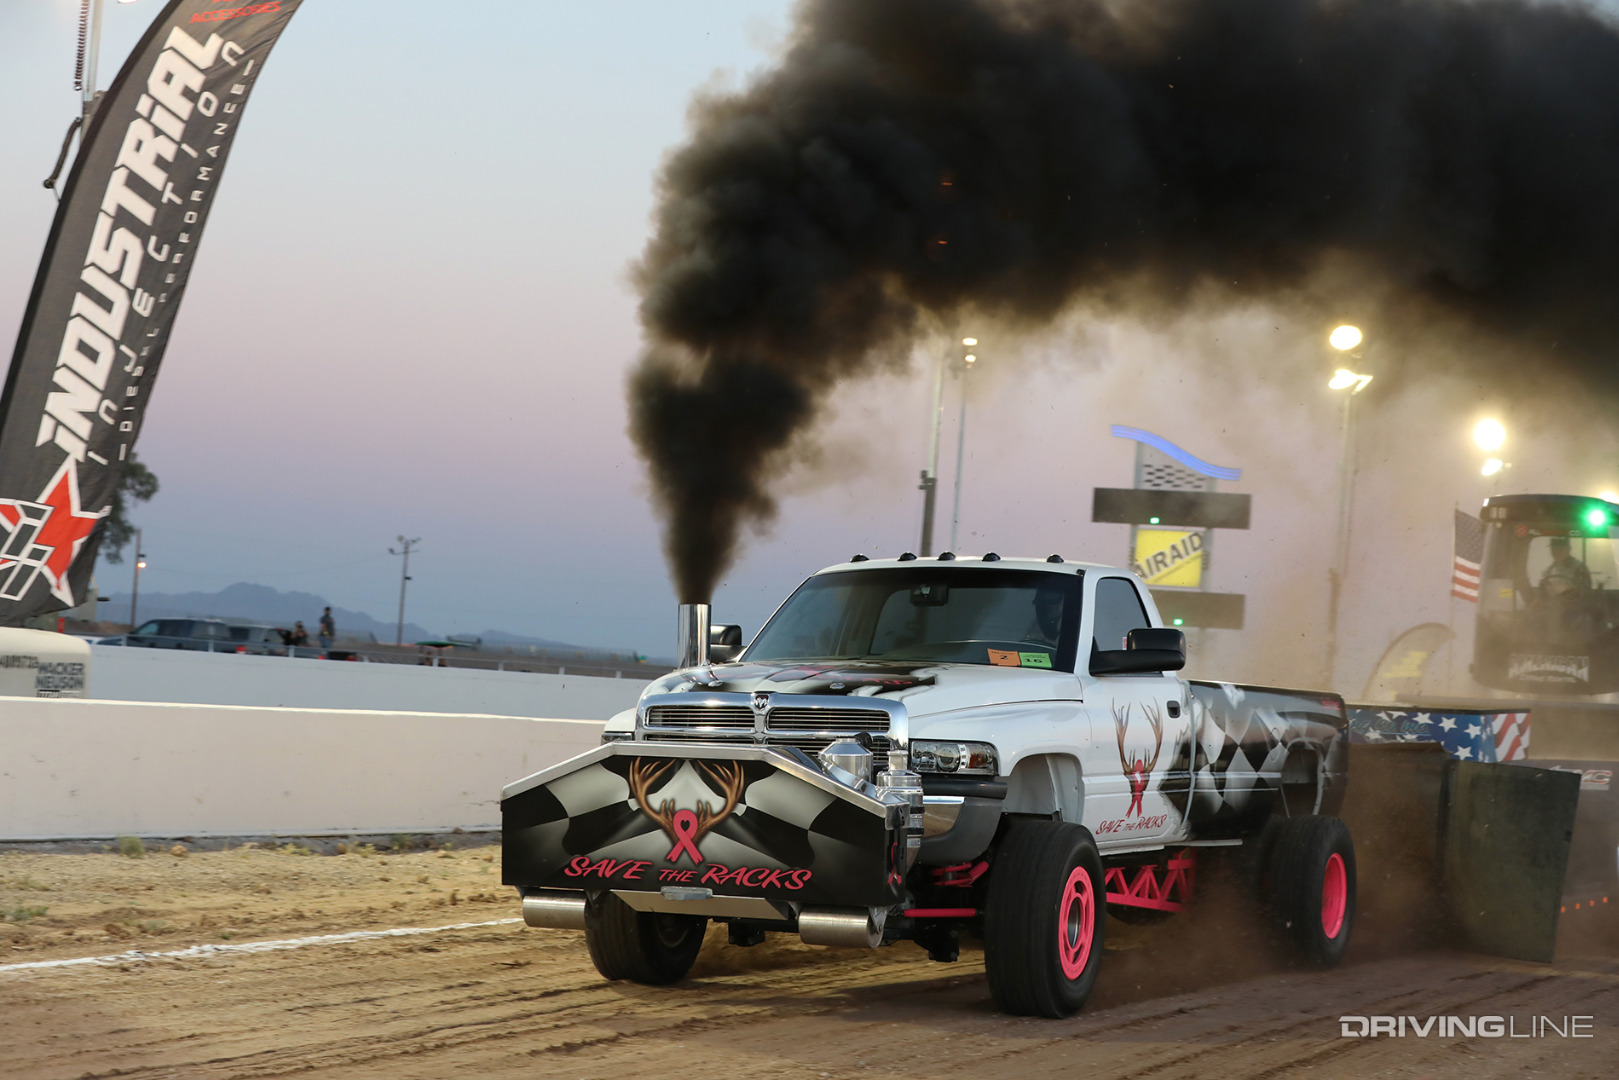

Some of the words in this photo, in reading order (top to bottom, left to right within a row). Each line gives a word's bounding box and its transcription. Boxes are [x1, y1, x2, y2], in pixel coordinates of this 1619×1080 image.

[188, 1, 281, 24] ACCESSORIES
[158, 83, 246, 303] PERFORMANCE
[1133, 531, 1204, 579] AIRAID
[1095, 818, 1126, 836] SAVE
[1123, 822, 1137, 832] THE
[1134, 813, 1168, 831] RACKS
[563, 856, 653, 881] SAVE
[658, 868, 699, 883] THE
[700, 863, 813, 891] RACKS
